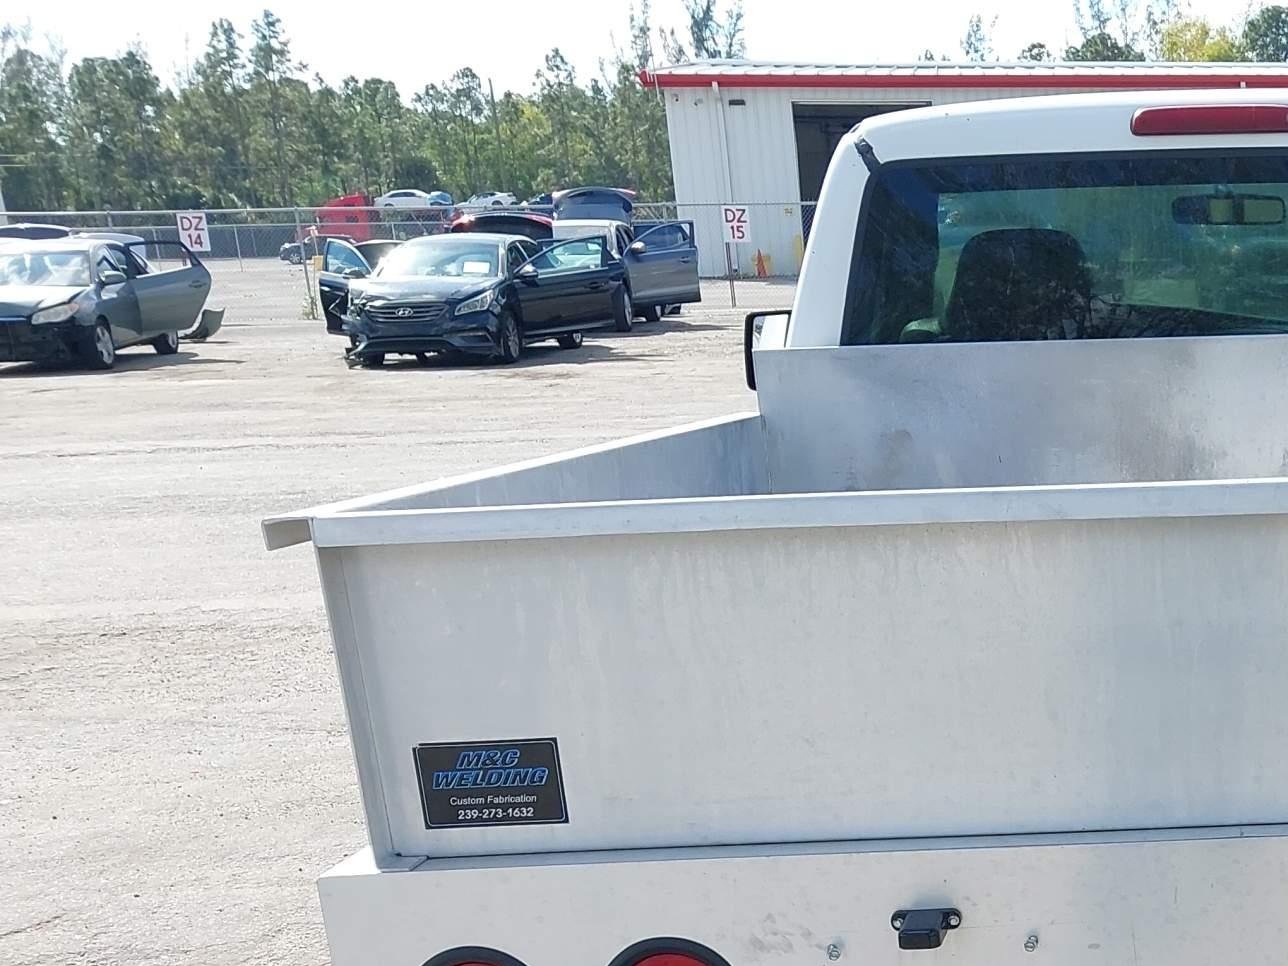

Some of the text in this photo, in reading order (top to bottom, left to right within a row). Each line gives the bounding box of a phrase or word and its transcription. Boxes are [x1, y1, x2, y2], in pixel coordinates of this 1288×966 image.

[179, 215, 205, 231] DZ
[723, 208, 747, 223] DZ
[730, 225, 745, 239] 15
[187, 232, 203, 248] 14
[456, 749, 520, 769] M&C
[432, 767, 548, 790] WELDING
[450, 793, 537, 806] Custom Fabrication
[457, 807, 535, 820] 239-273-1632
